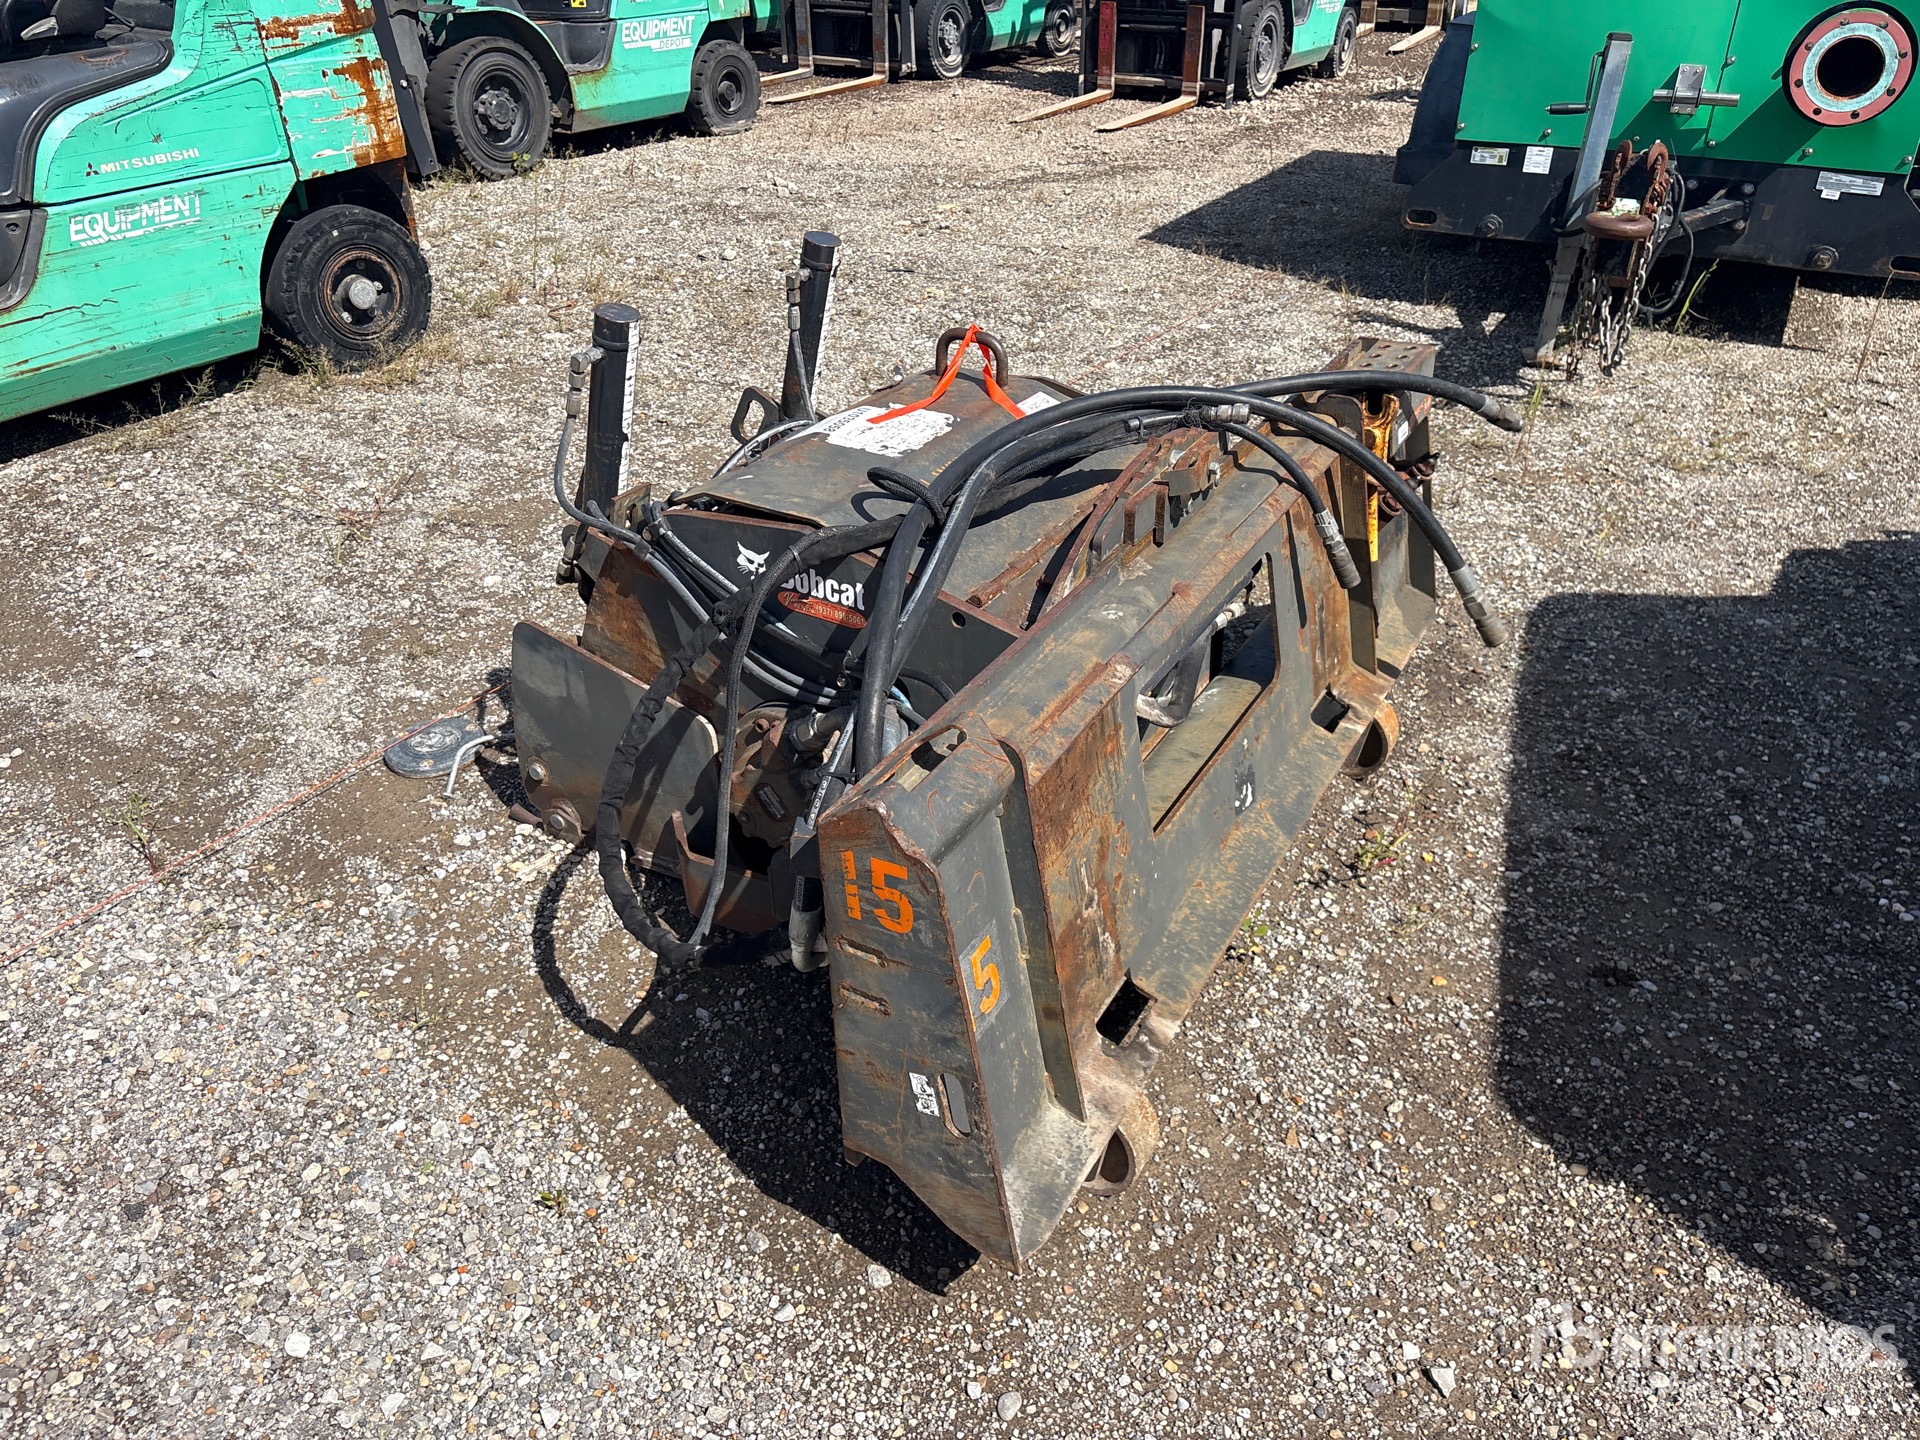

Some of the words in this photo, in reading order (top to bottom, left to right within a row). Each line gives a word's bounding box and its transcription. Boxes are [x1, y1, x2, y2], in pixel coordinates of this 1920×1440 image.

[621, 15, 696, 42] EQUIPMENT
[659, 37, 687, 49] DEPOT
[99, 147, 200, 174] MITSUBISHI
[69, 191, 202, 243] EQUIPMENT
[815, 604, 833, 617] (937)
[841, 850, 914, 934] 15
